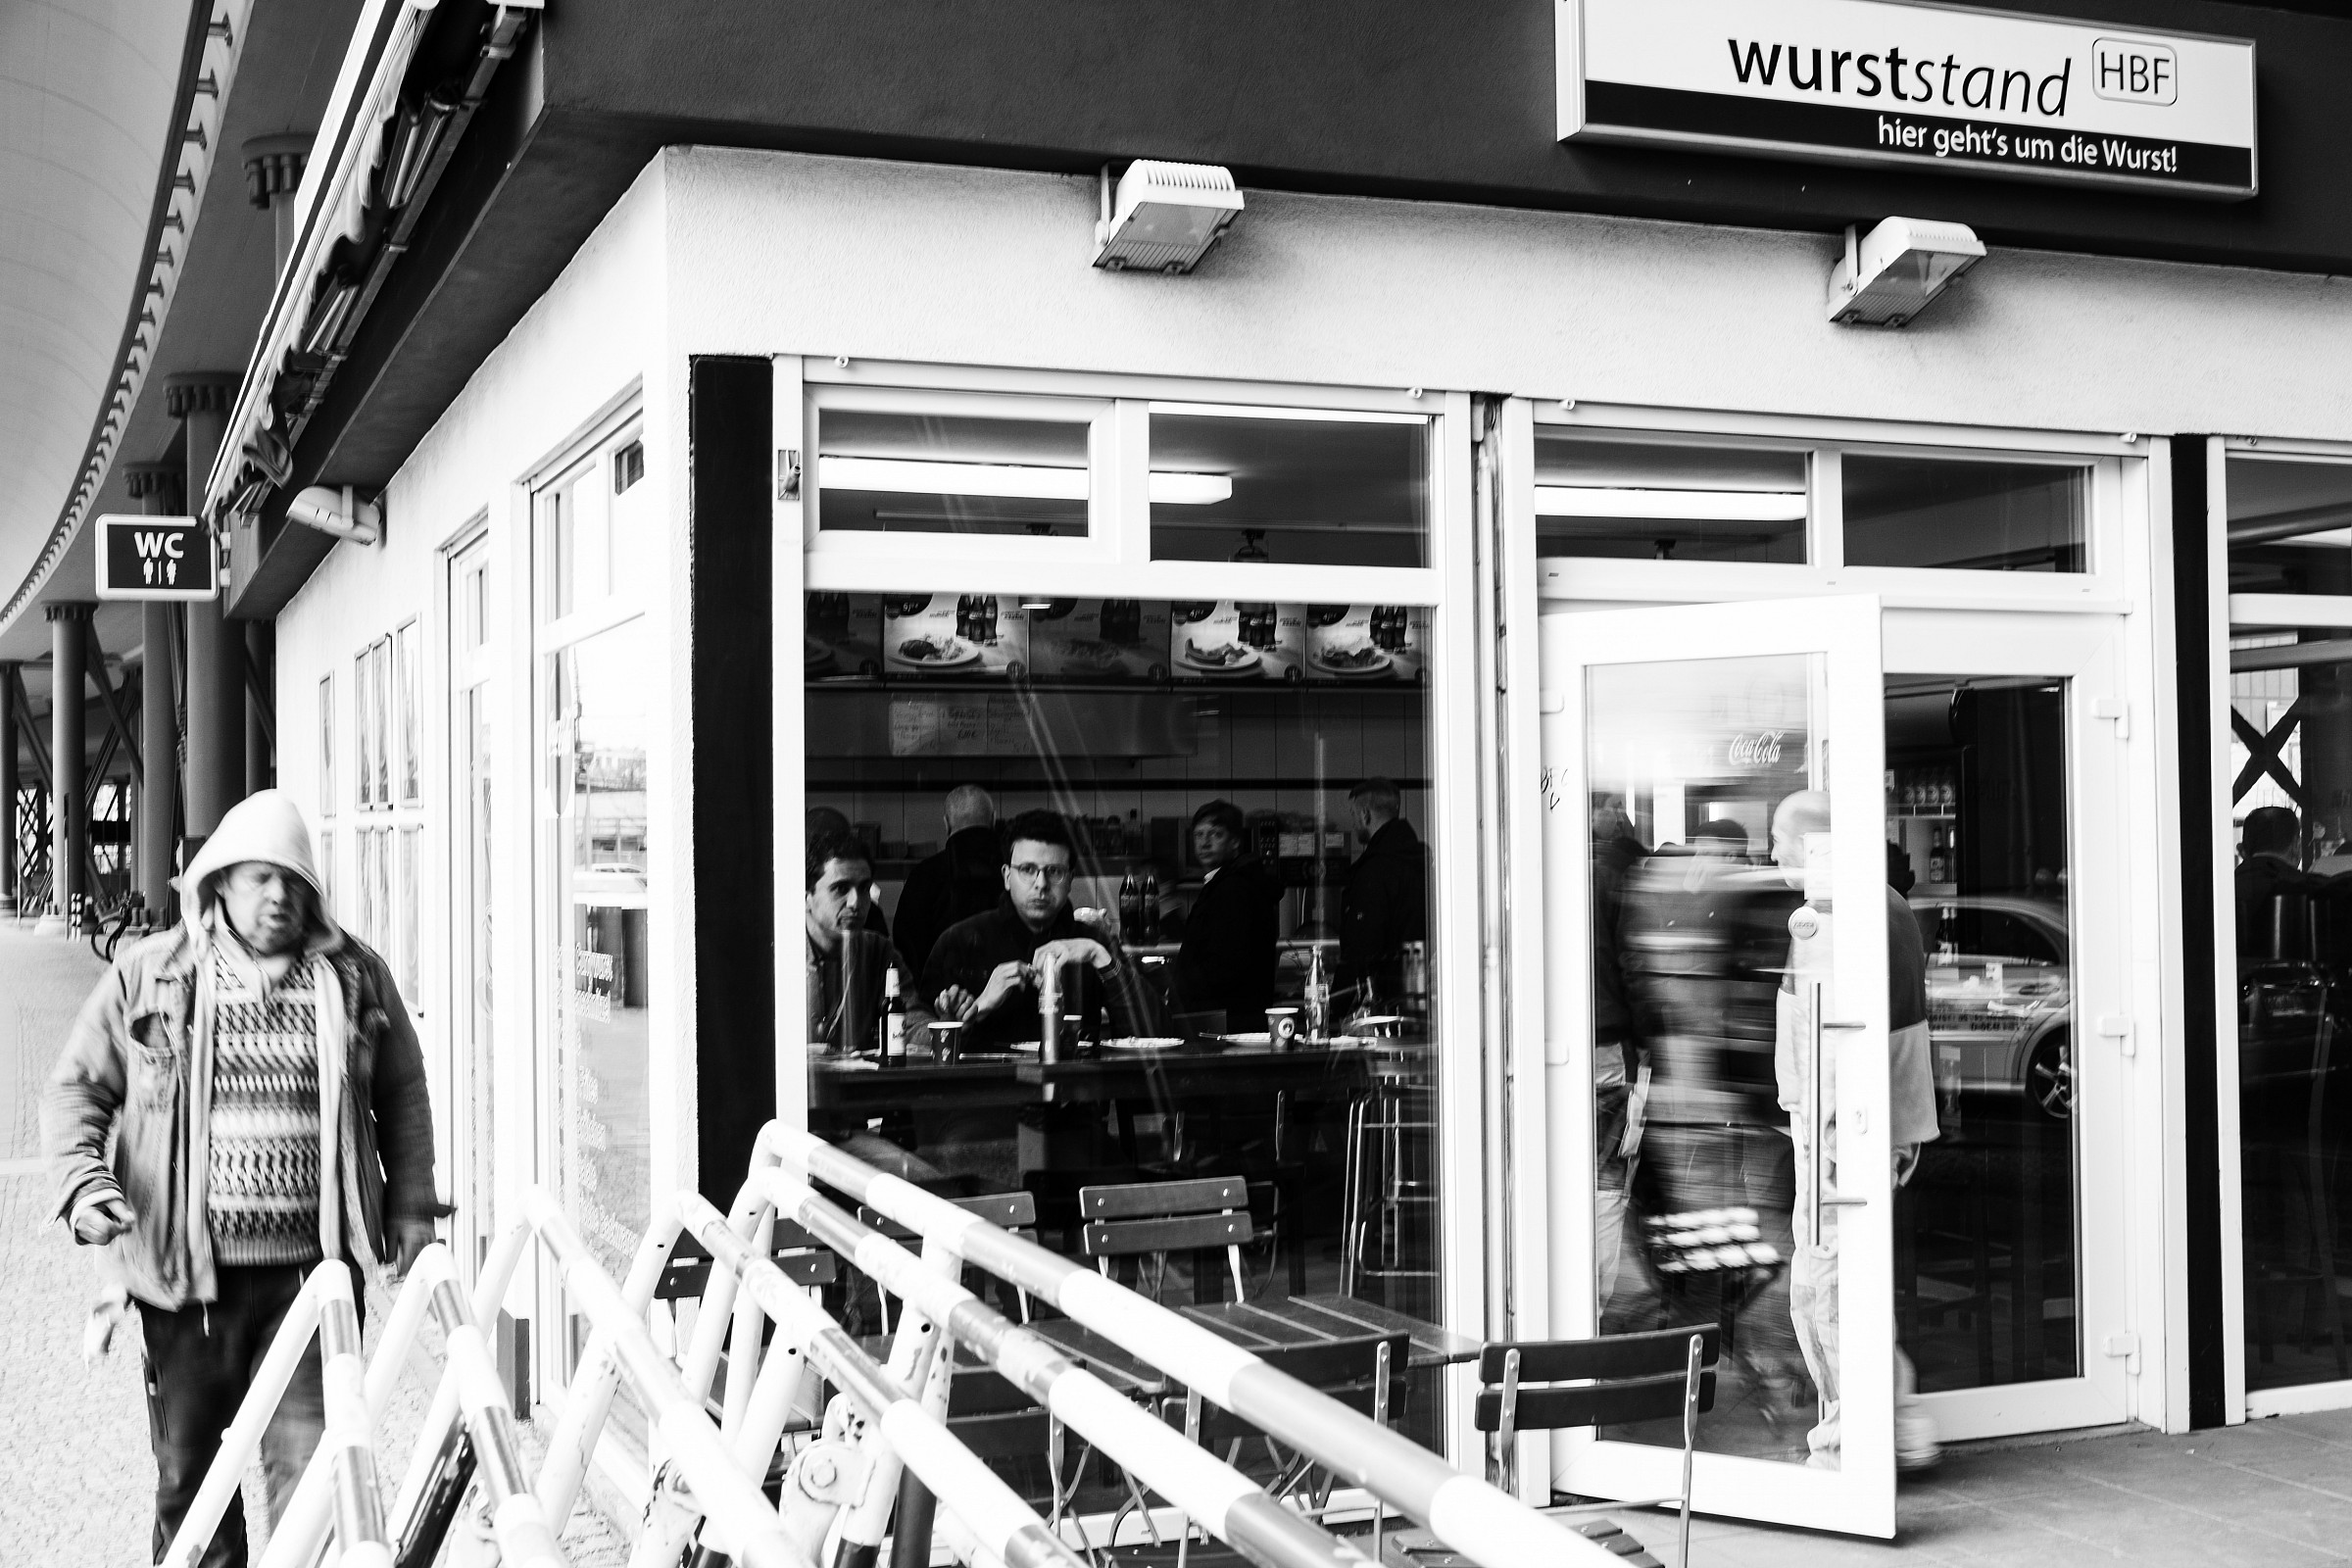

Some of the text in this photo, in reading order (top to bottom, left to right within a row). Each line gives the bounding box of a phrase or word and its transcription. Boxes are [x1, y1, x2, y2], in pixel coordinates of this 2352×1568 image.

[1728, 38, 2072, 117] wurststand
[2100, 52, 2172, 95] HBF
[1878, 116, 2178, 173] hier geht's um die Wurst!
[134, 531, 184, 559] WC
